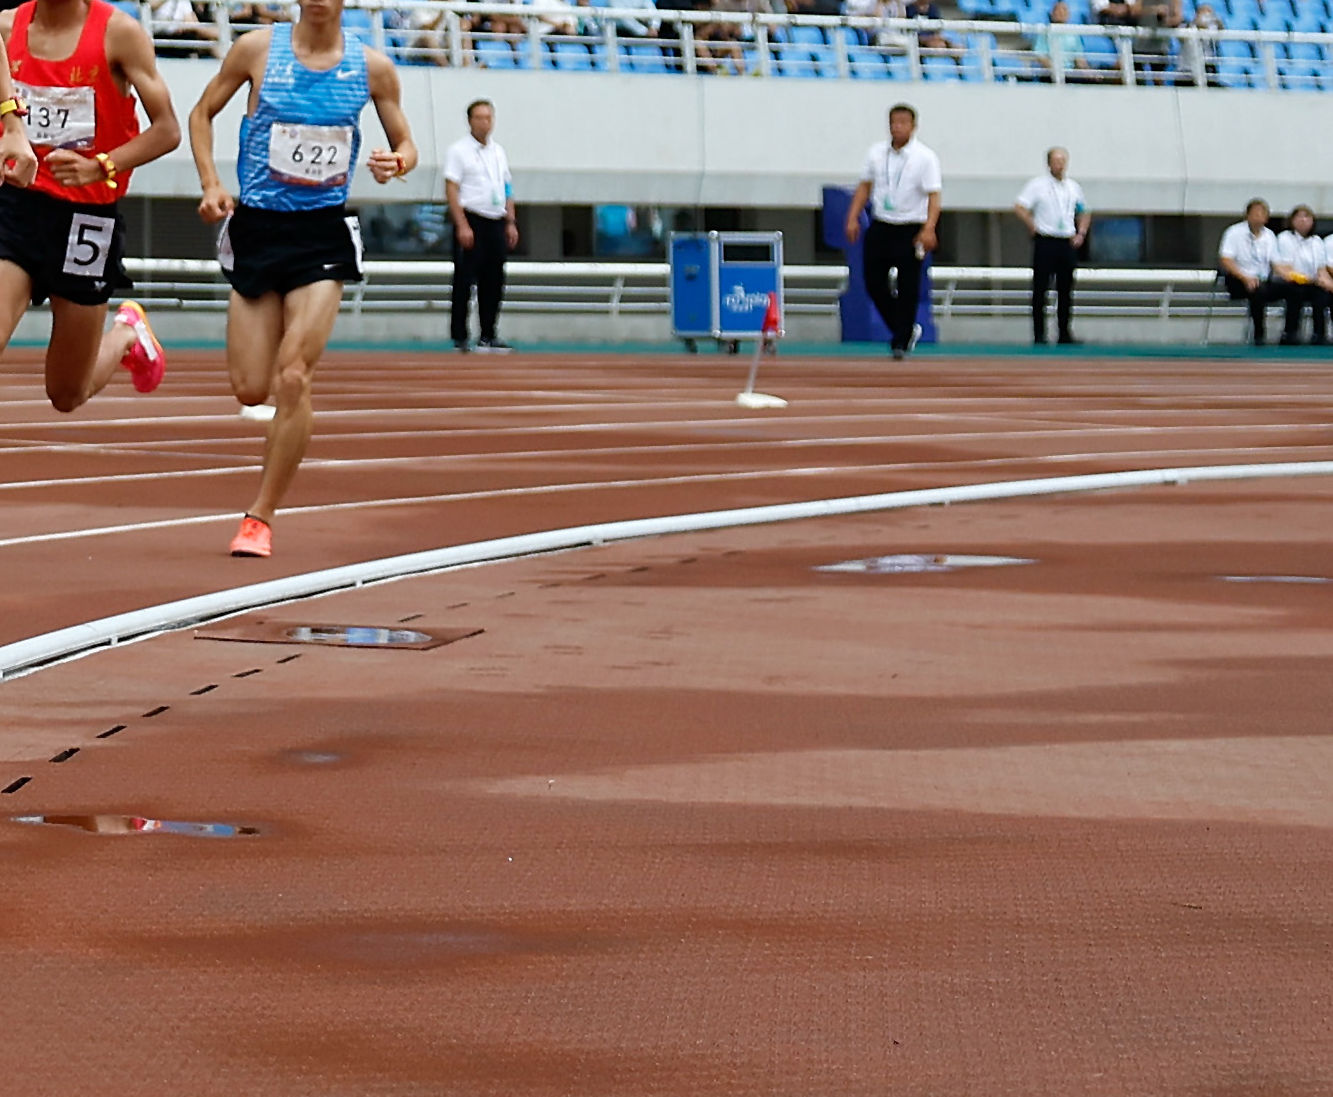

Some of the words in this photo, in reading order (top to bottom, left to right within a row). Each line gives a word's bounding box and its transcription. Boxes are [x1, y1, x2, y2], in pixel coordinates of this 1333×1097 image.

[26, 105, 70, 129] 137
[292, 144, 338, 166] 622
[73, 223, 104, 266] 5
